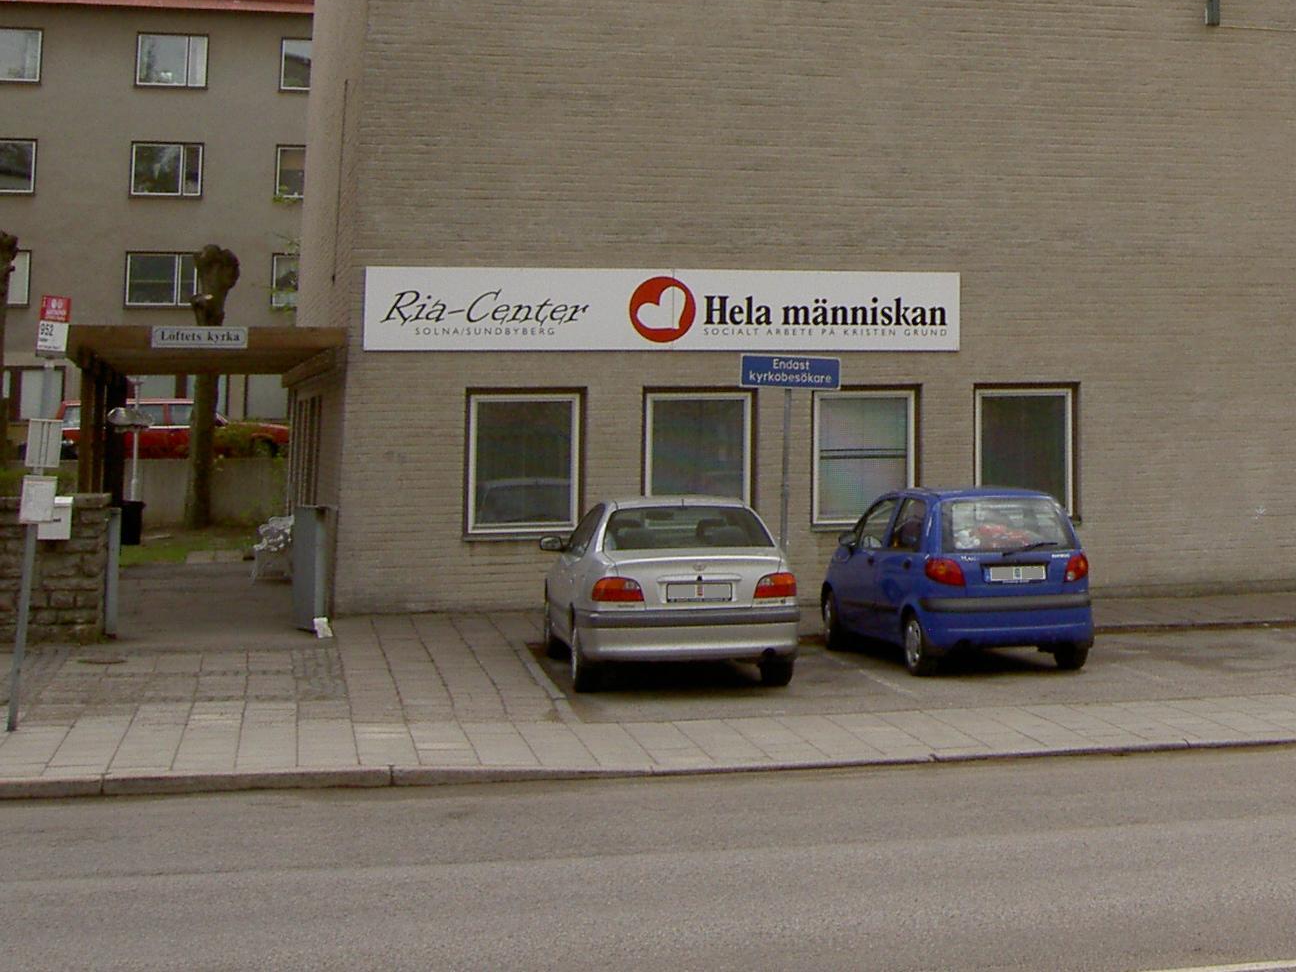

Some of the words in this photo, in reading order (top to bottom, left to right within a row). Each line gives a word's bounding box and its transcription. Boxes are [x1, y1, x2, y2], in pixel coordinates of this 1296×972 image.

[380, 289, 589, 326] Ria-Center
[703, 295, 773, 326] Hela
[782, 297, 947, 326] människan
[207, 331, 241, 343] kyrka
[415, 327, 556, 336] SOLNA/SUNDBYBERG
[703, 327, 760, 336] SOCIALT
[766, 327, 812, 336] ARBETE
[843, 328, 897, 336] KRISTEN
[904, 328, 948, 337] GRUND
[772, 358, 810, 370] Endast
[749, 370, 832, 383] kyrkobesökare
